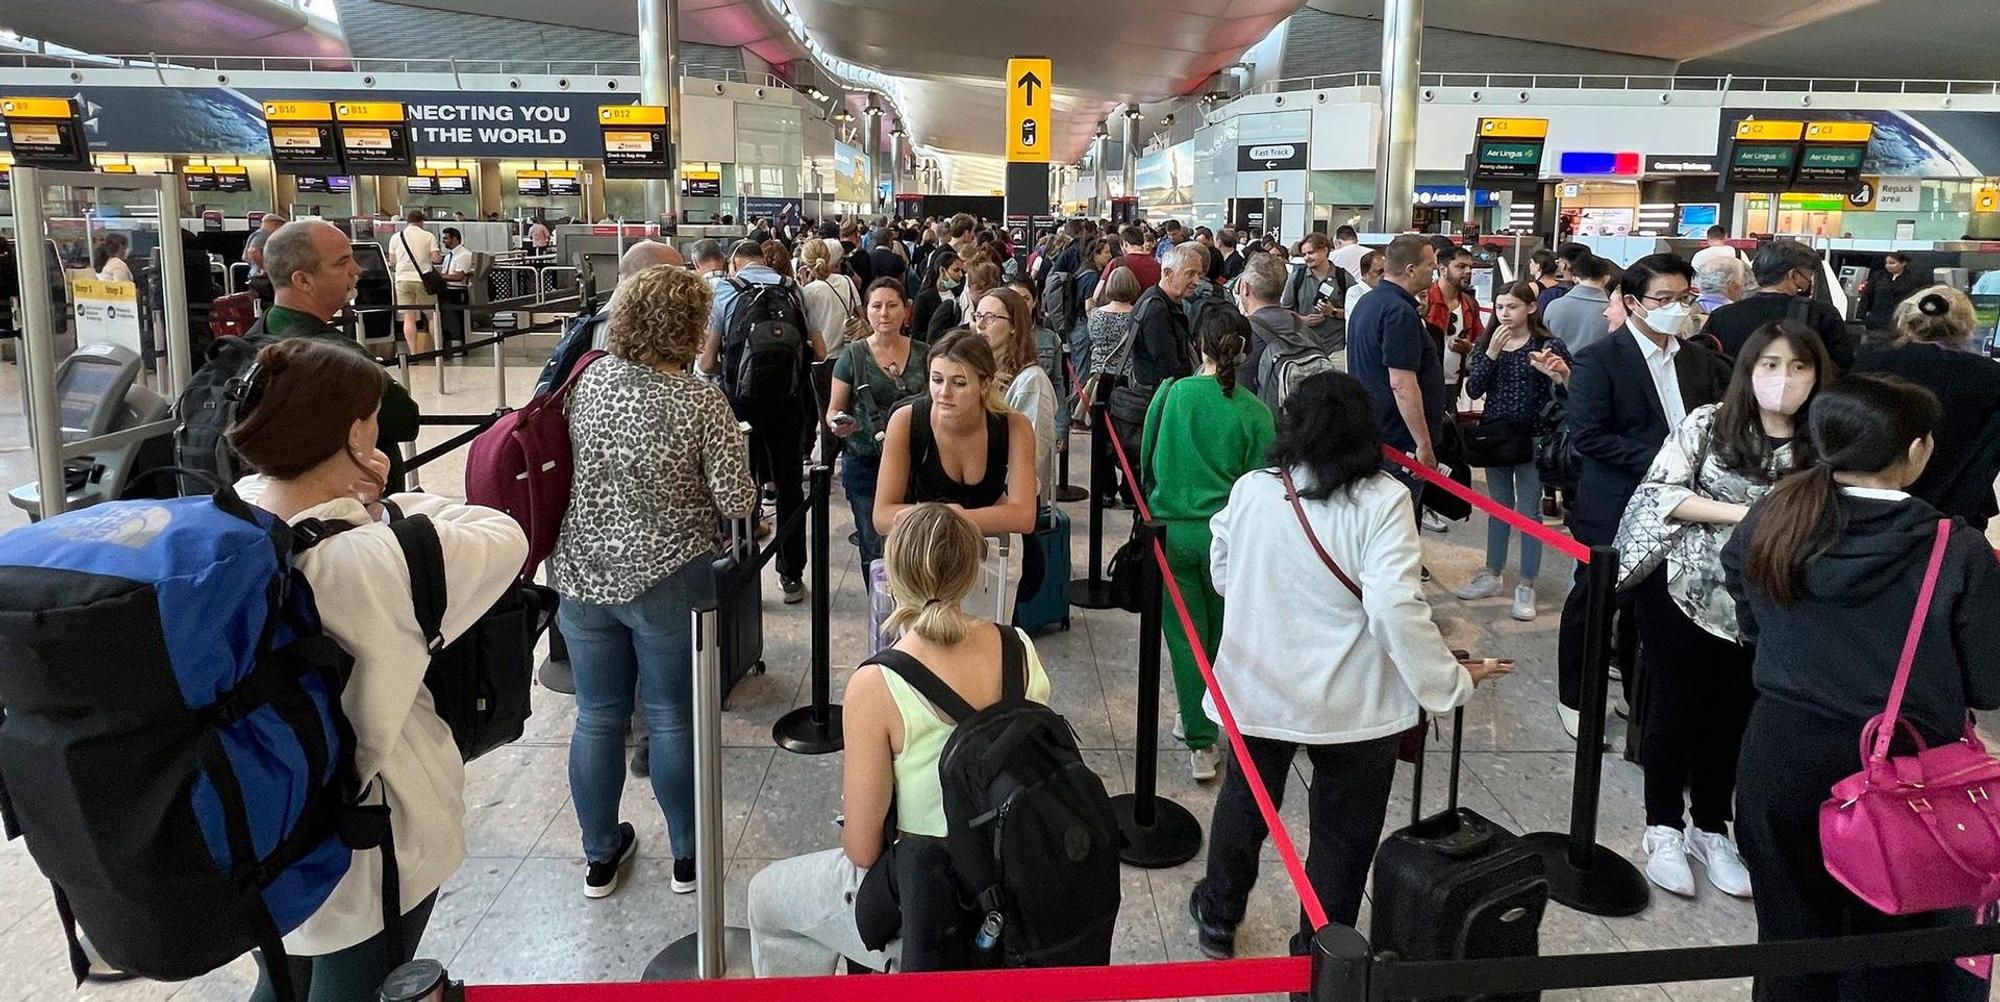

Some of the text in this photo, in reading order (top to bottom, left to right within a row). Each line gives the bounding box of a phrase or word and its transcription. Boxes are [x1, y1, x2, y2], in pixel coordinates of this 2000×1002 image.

[278, 105, 296, 113] B10
[351, 105, 368, 114] B11
[407, 105, 570, 122] NECTING YOU
[614, 110, 631, 118] B12
[1497, 121, 1508, 130] C1
[1752, 125, 1764, 133] C2
[424, 127, 473, 143] THE
[478, 128, 567, 144] WORLD
[1255, 148, 1289, 157] Fast Track
[1487, 148, 1523, 159] Aer Lingus
[1741, 152, 1777, 161] Aer Lingus
[1810, 153, 1845, 162] Aer Lingus
[1882, 184, 1914, 194] Repack
[1430, 192, 1466, 202] Assistan
